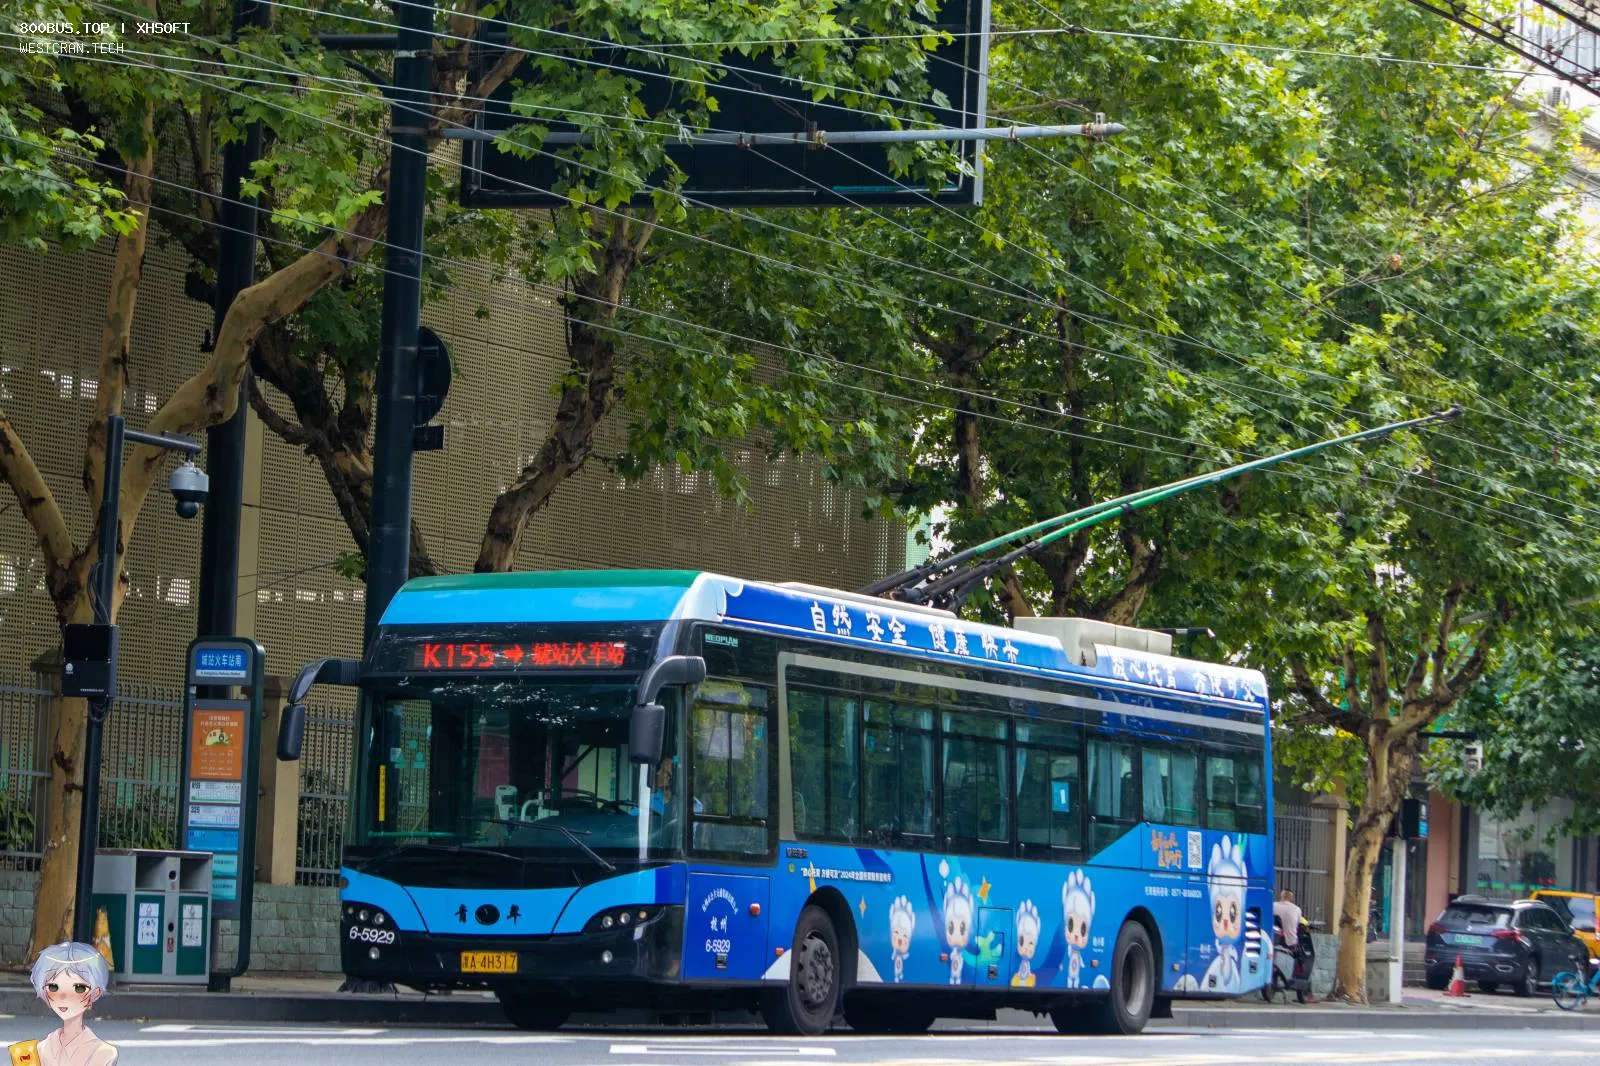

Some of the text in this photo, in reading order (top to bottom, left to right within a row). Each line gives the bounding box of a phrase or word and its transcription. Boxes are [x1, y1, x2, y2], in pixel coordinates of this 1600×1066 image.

[865, 612, 907, 645] 安全
[705, 633, 738, 647] NEOPLAN
[423, 641, 625, 668] K155 城站火车站
[350, 926, 395, 945] 6-5929
[705, 938, 731, 953] 6-5929
